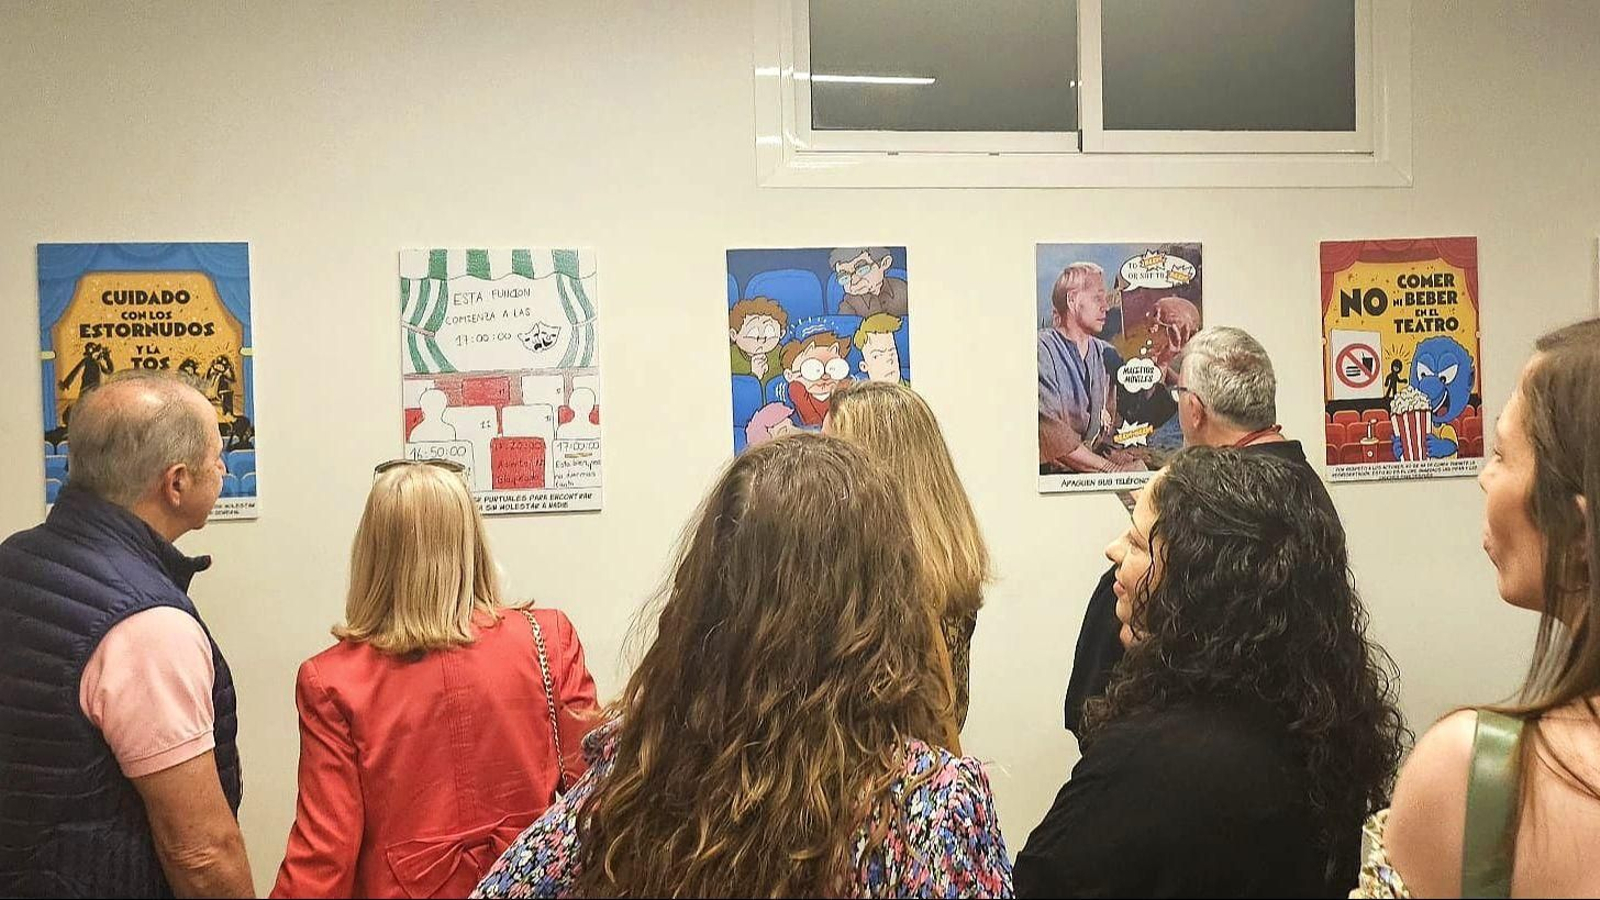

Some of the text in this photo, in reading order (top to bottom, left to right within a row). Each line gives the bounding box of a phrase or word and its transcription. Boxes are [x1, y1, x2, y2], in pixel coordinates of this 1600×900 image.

[1397, 273, 1455, 289] COMER
[101, 290, 191, 305] CUIDADO
[453, 291, 484, 306] ESTA
[1340, 288, 1388, 317] NO
[1393, 290, 1458, 307] NI BEBER
[121, 311, 173, 320] CON LOS
[502, 310, 509, 318] A
[513, 307, 531, 318] LAS
[1415, 309, 1427, 317] EN
[79, 322, 215, 338] ESTORNUDOS
[1394, 317, 1459, 334] TEATRO
[136, 345, 161, 355] Y LA
[131, 356, 170, 370] TOS
[1061, 479, 1095, 487] APAGUEN
[1115, 476, 1149, 485] TELÉFONO
[484, 495, 526, 503] PUNTUALES
[549, 492, 592, 501] ENCONTRAR
[500, 502, 539, 510] MOLESTAR
